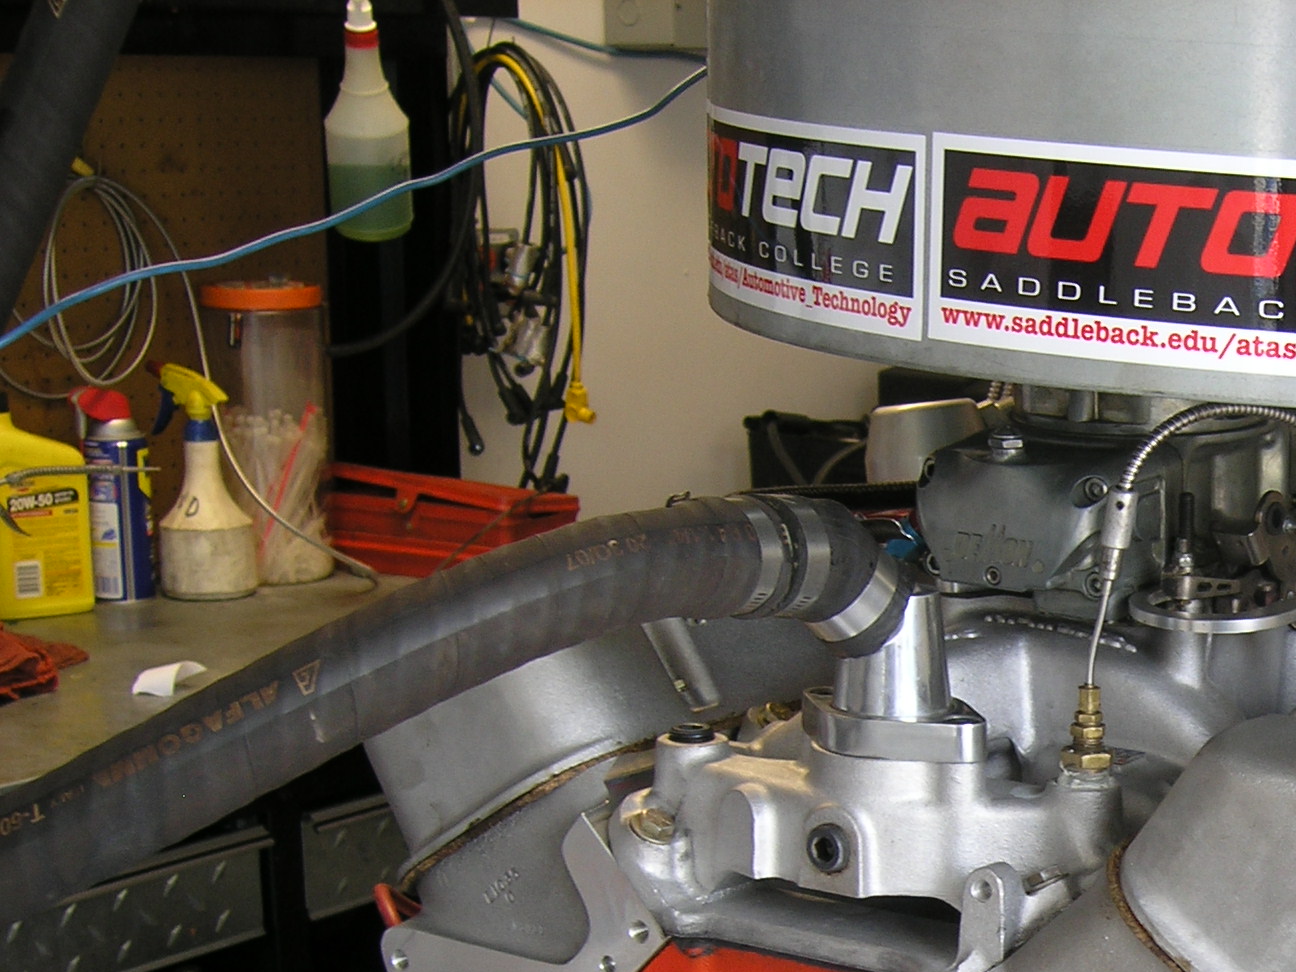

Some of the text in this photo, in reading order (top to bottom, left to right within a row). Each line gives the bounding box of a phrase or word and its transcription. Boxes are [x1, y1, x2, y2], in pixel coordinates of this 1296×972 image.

[711, 221, 894, 283] BACK COLLEGE
[9, 492, 54, 513] 20W-50
[92, 681, 279, 787] ALFAGOMMA
